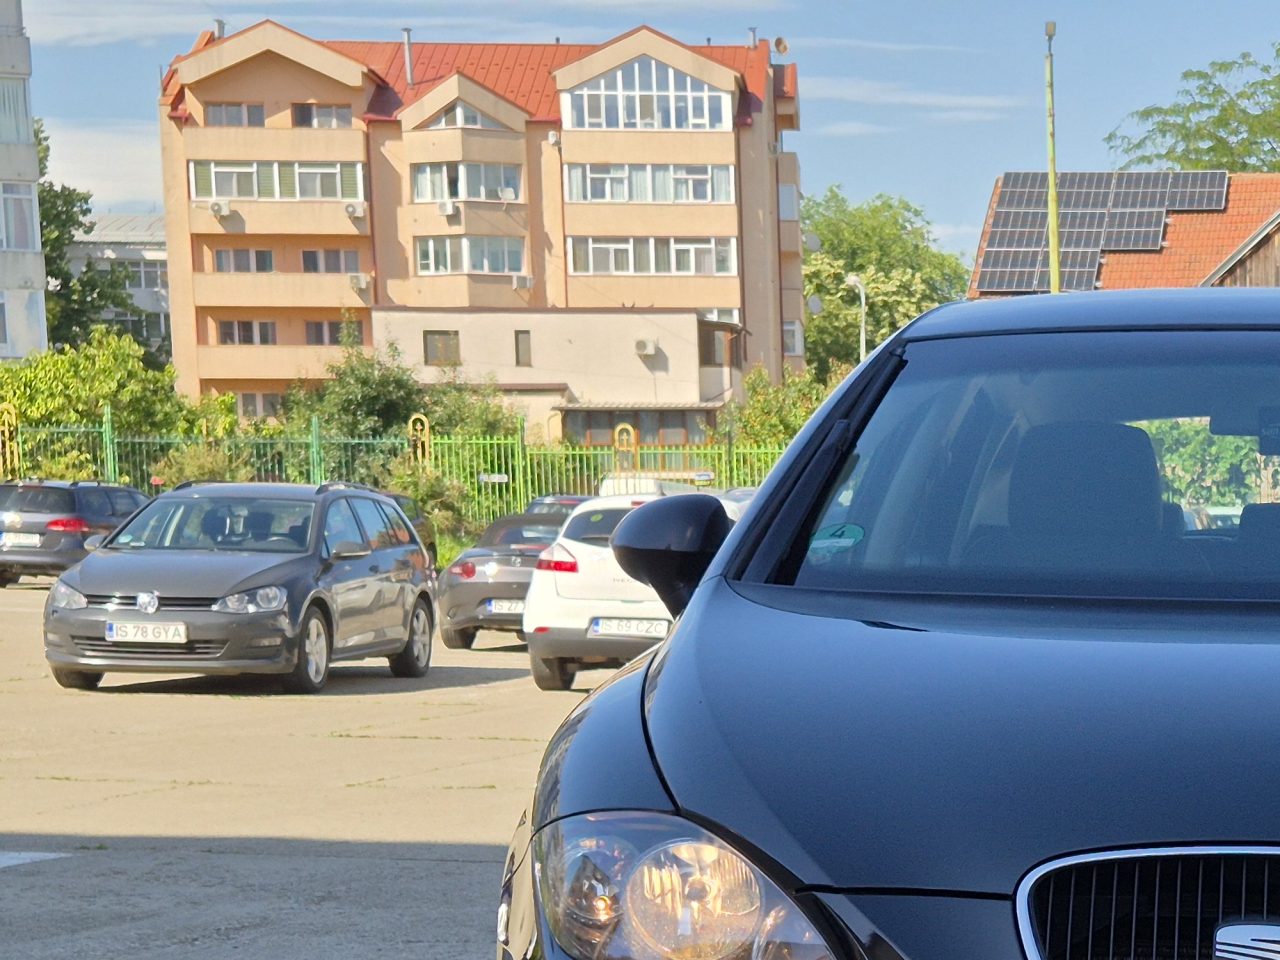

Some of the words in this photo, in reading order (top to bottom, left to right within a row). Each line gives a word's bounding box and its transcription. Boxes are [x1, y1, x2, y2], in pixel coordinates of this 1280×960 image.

[829, 524, 847, 539] 4
[115, 625, 129, 639] IS
[132, 625, 149, 639] 78
[152, 625, 182, 640] GYA
